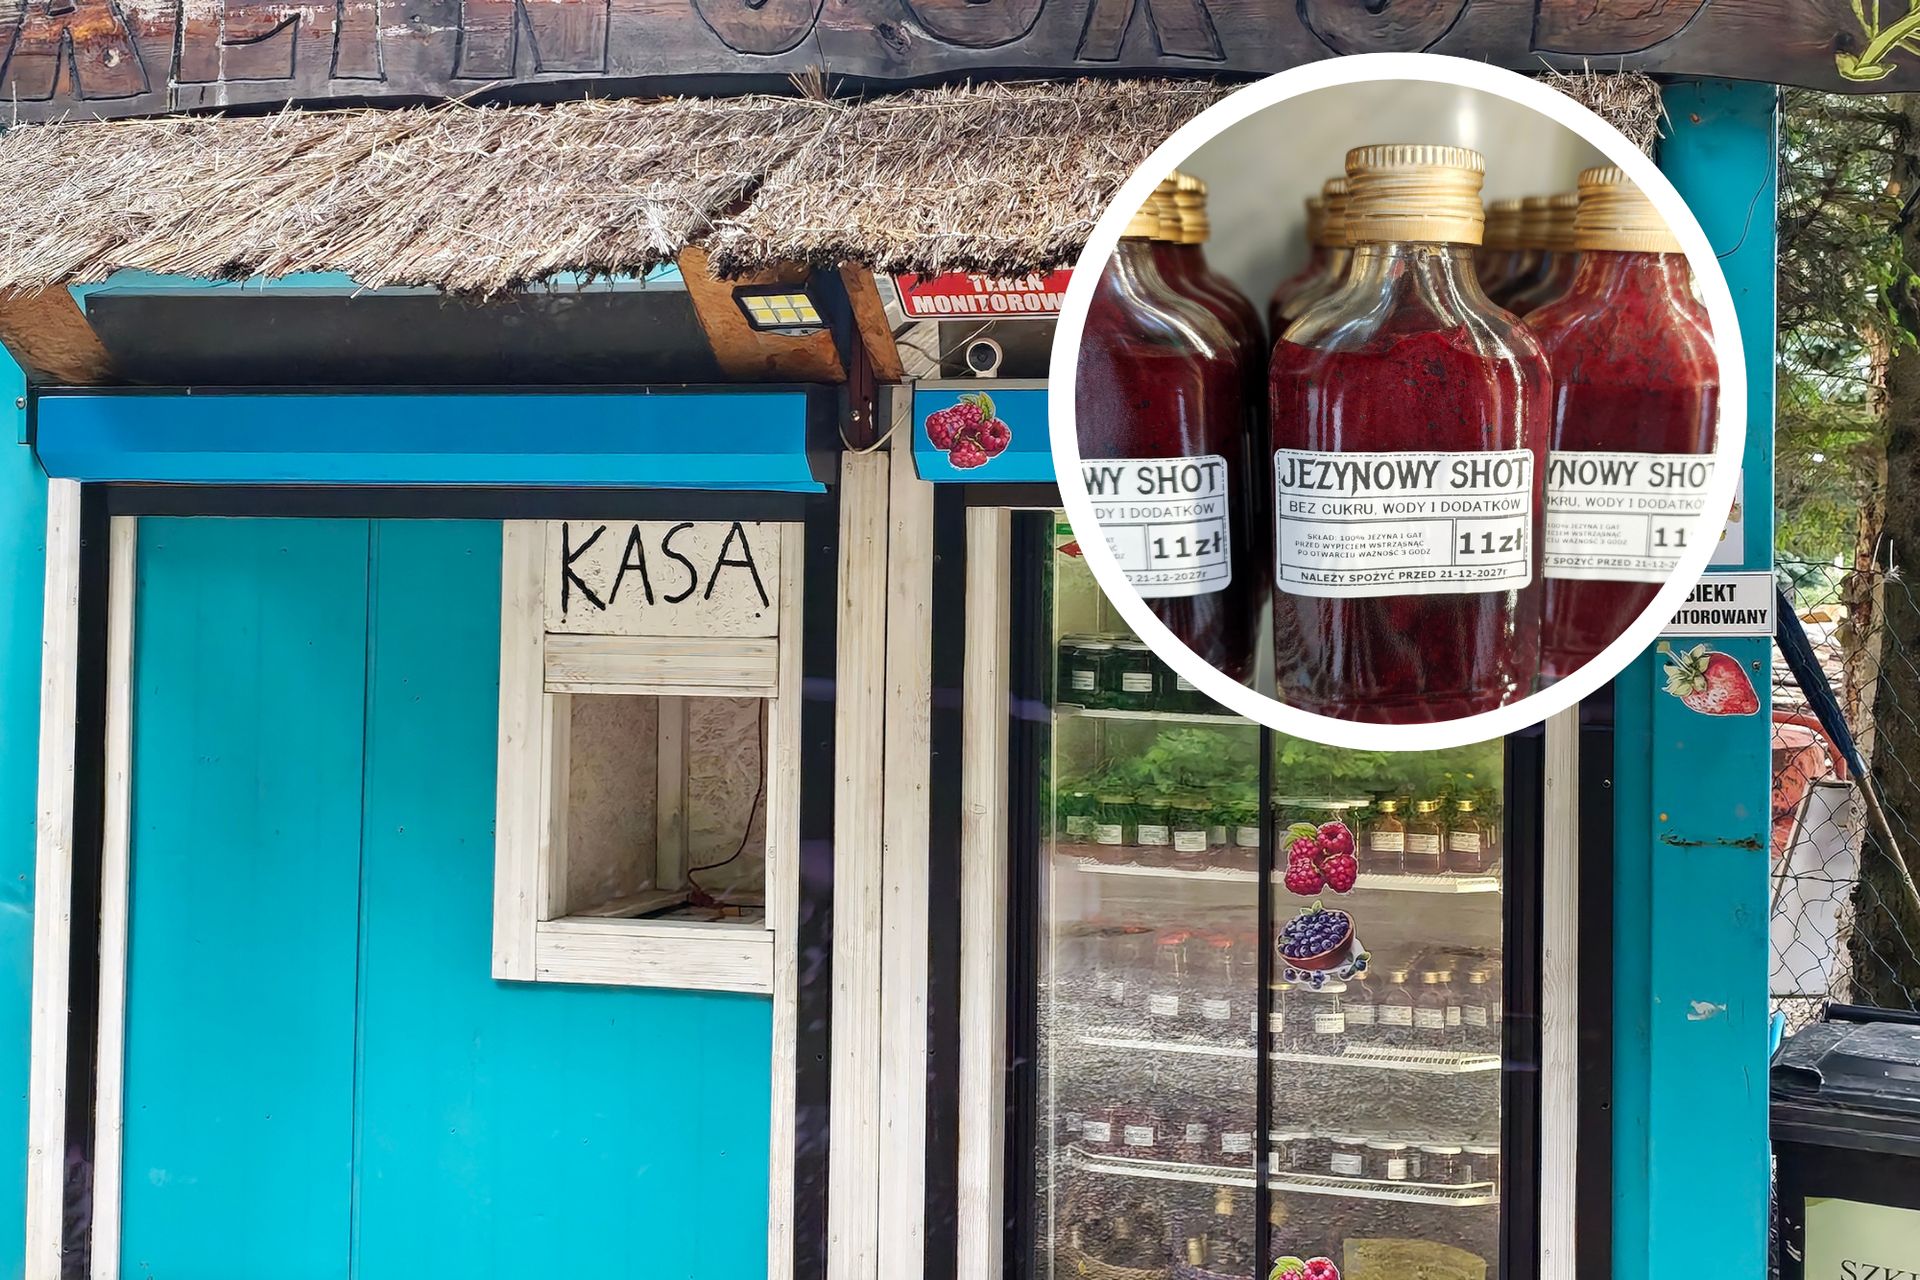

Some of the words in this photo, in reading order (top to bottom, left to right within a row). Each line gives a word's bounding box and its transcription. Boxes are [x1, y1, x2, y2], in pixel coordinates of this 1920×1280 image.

[1137, 462, 1221, 495] SHOT
[1281, 458, 1441, 496] JEZYNOWY
[1450, 457, 1529, 489] SHOT
[1131, 503, 1215, 518] DODATKÓW
[1290, 501, 1316, 514] BEZ
[1322, 503, 1377, 516] CUKRU,
[1383, 502, 1426, 514] WODY
[1431, 503, 1435, 512] I
[1441, 498, 1520, 513] DODATKÓW
[1585, 497, 1624, 508] WODY
[1629, 498, 1633, 507] I
[1638, 498, 1705, 509] DODATKÓ
[1153, 531, 1222, 559] 11zł
[1459, 528, 1524, 555] 11zł
[561, 521, 770, 614] KASA
[1597, 558, 1632, 567] PRZED
[1137, 571, 1207, 582] 21-12-2027r
[1301, 571, 1345, 583] NALEŻY
[1349, 570, 1394, 582] SPOŻYĆ
[1399, 570, 1436, 580] PRZED
[1440, 568, 1508, 578] 21-12-2027r
